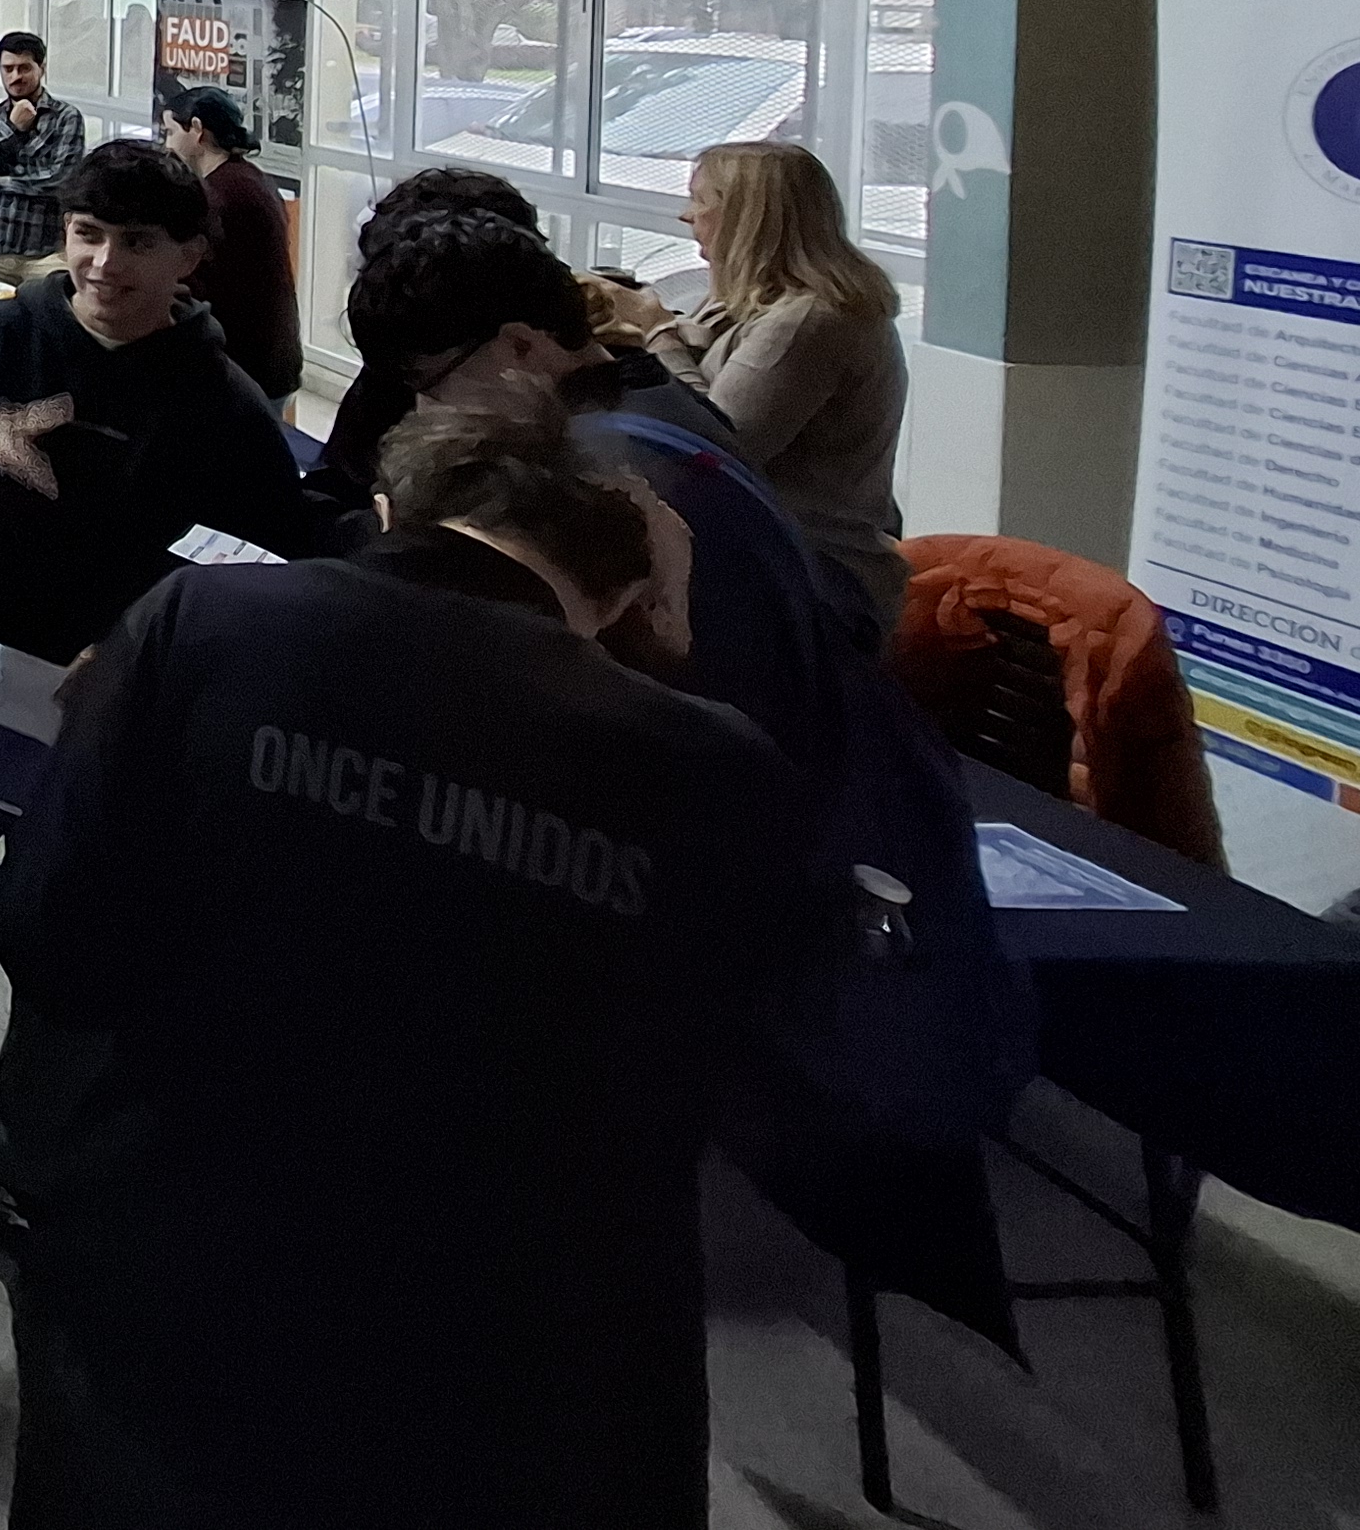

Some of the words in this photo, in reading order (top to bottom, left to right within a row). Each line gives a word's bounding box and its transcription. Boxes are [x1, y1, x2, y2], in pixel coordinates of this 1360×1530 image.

[166, 17, 229, 49] FAUD
[166, 47, 228, 71] UNMDP
[250, 725, 405, 827] ONCE
[418, 772, 652, 915] UNIDOS
